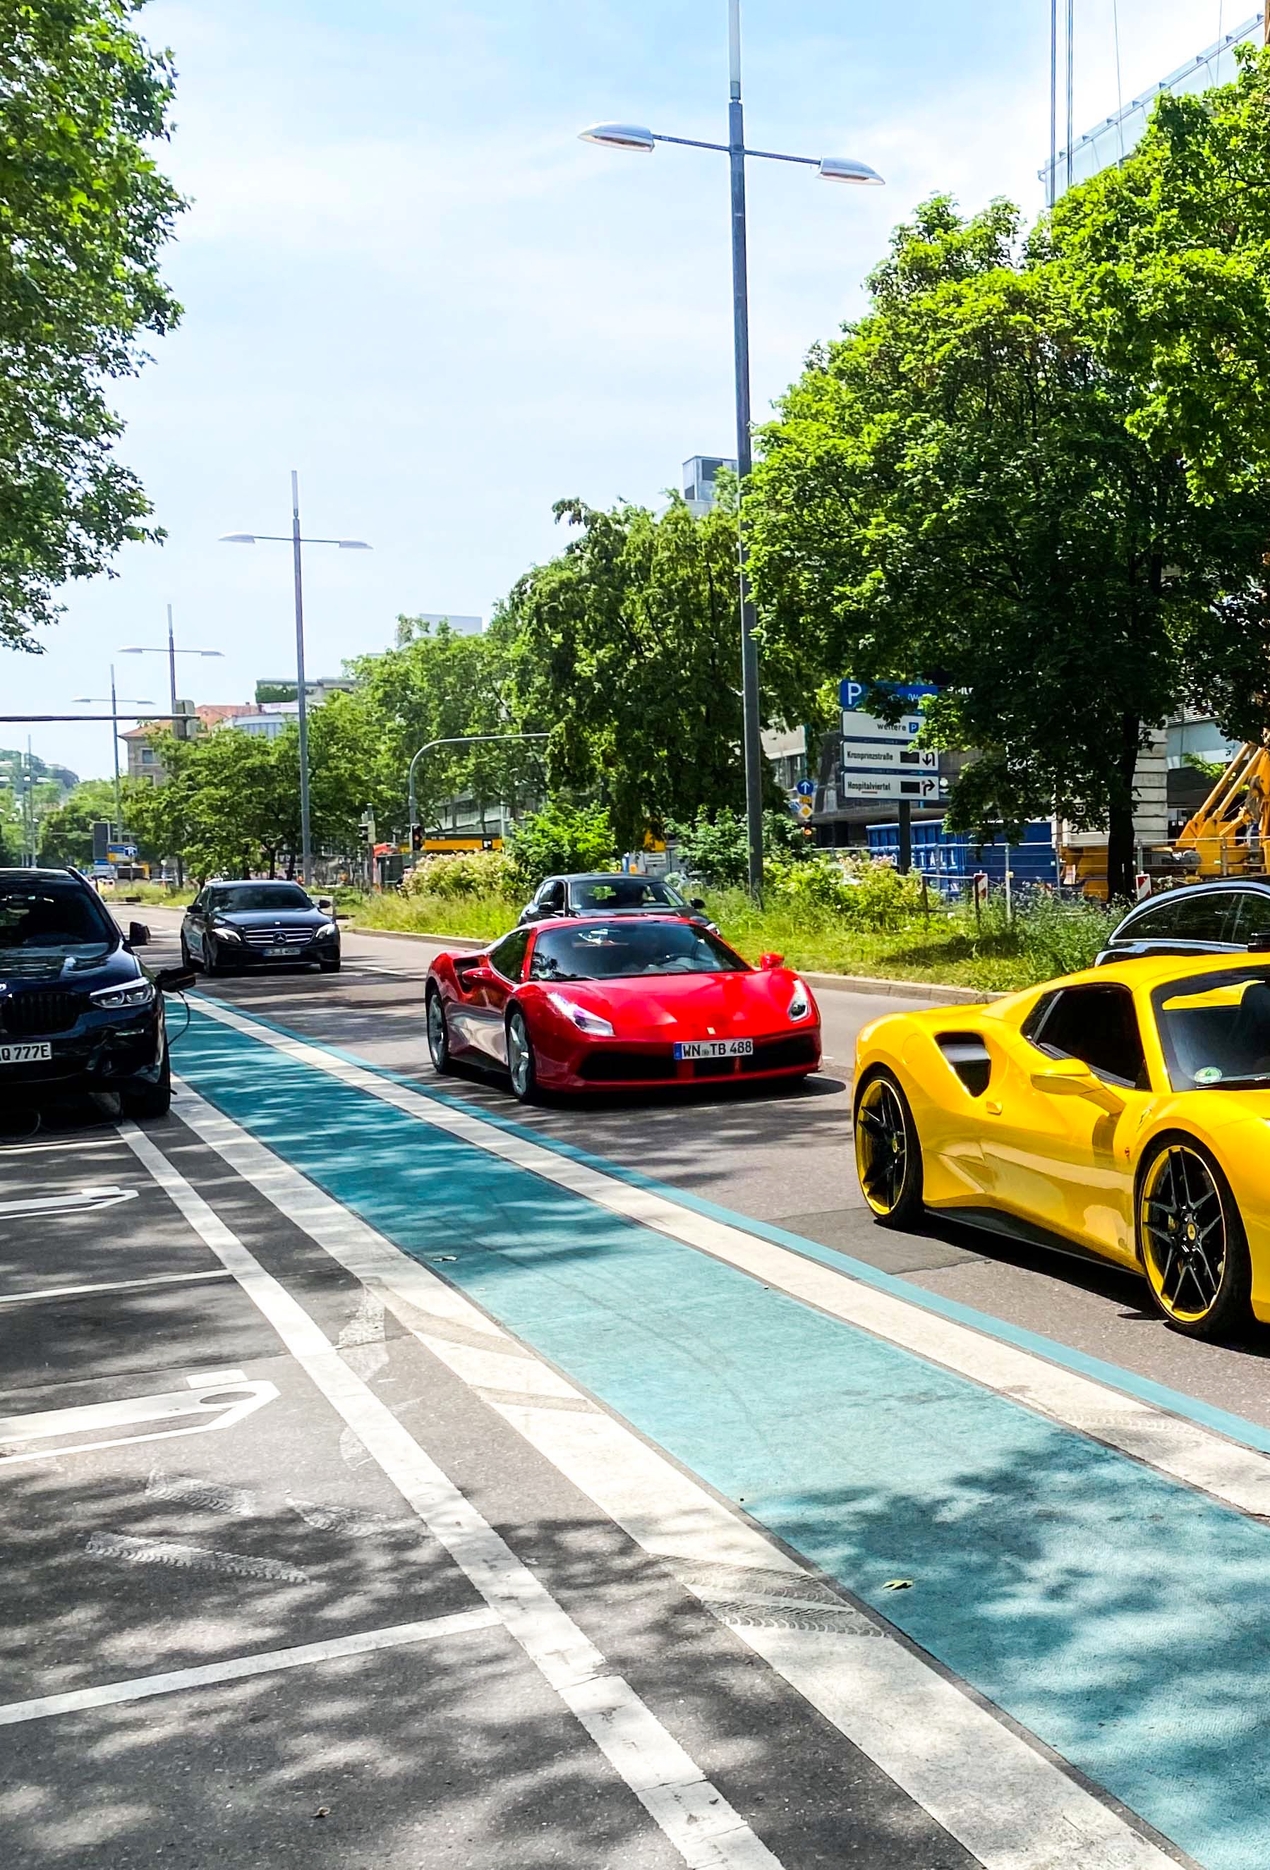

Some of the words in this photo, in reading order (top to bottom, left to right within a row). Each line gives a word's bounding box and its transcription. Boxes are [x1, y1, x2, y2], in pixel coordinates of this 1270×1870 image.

[848, 682, 862, 705] P
[0, 1047, 11, 1061] Q
[683, 1044, 700, 1058] WN
[710, 1043, 726, 1056] TB
[730, 1040, 752, 1054] 488
